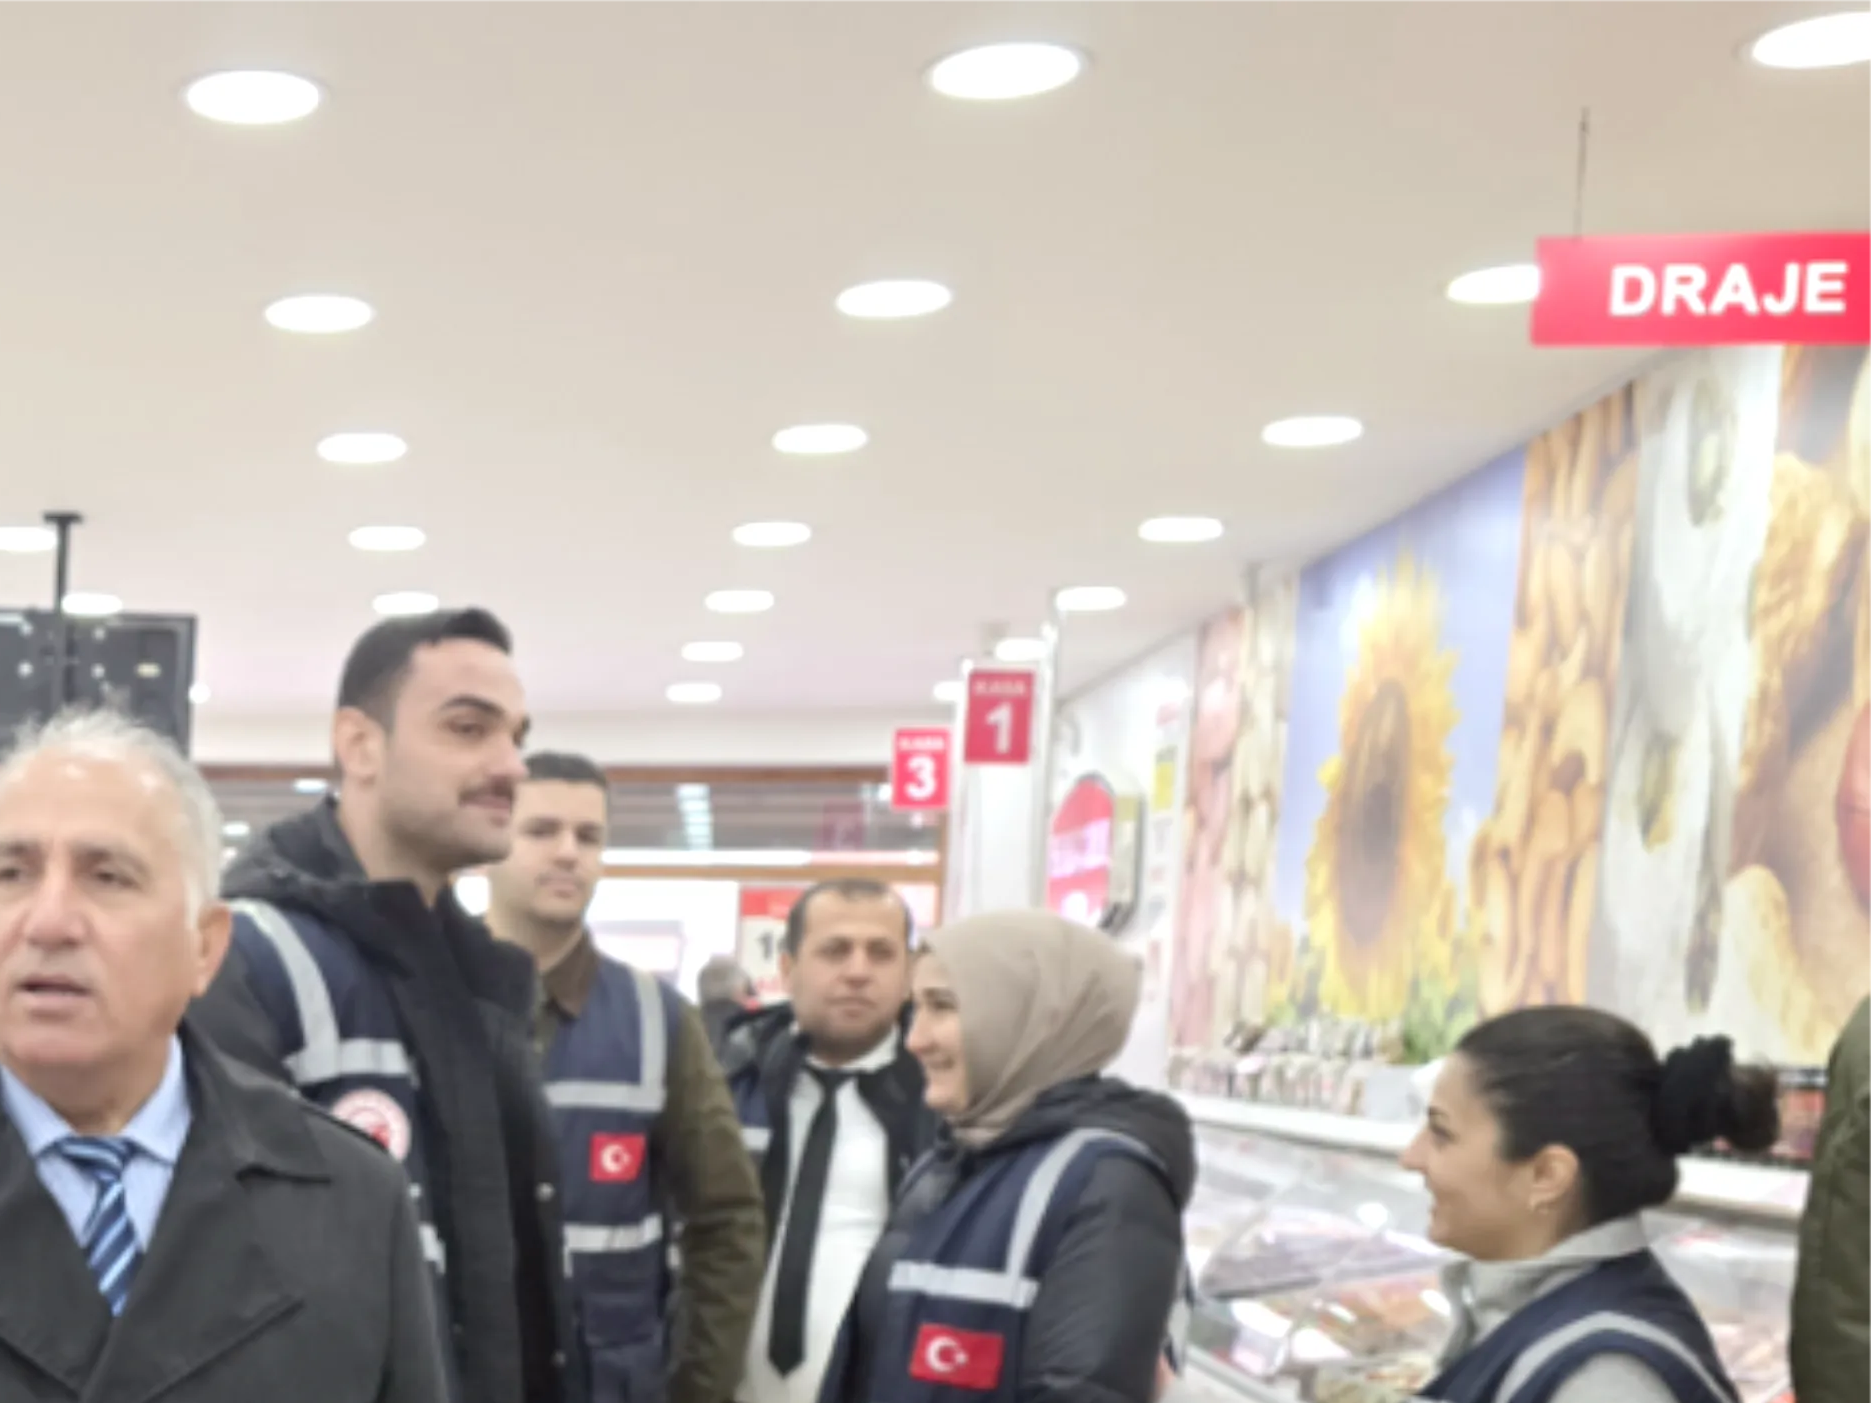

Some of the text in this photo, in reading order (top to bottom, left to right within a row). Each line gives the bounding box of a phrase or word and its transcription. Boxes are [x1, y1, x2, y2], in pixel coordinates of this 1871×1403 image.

[1609, 261, 1848, 317] DRAJE
[984, 700, 1013, 755] 1
[905, 755, 936, 800] 3
